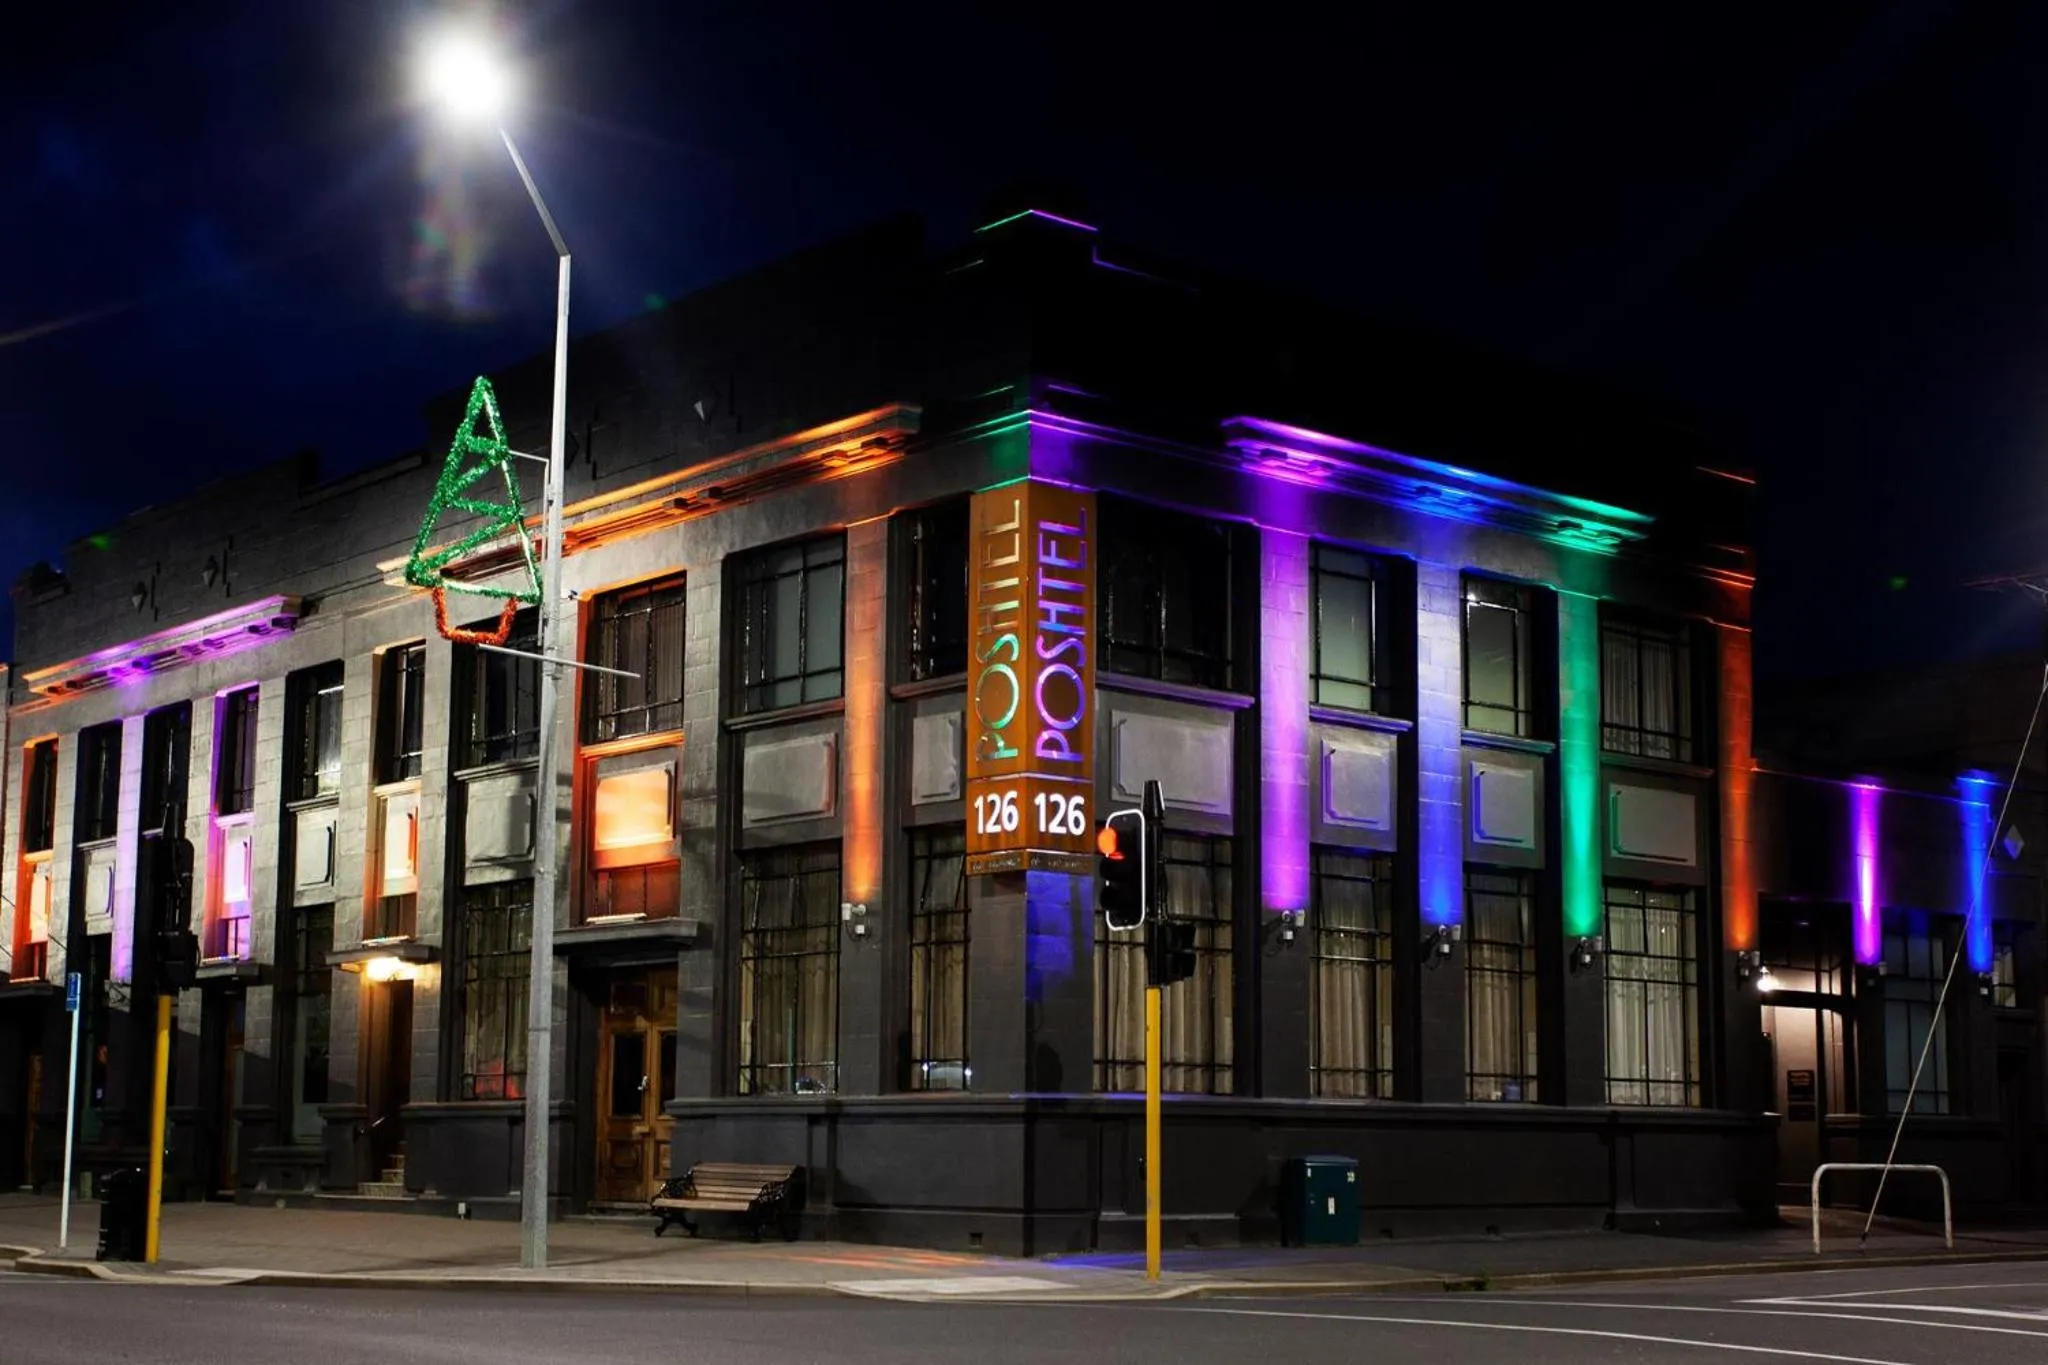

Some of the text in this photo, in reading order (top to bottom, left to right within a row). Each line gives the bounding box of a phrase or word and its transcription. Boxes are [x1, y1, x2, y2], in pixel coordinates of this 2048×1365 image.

[975, 499, 1020, 762] POSHTEL
[1035, 507, 1087, 762] POSHTEL
[974, 790, 1019, 834] 126
[1034, 793, 1086, 836] 126
